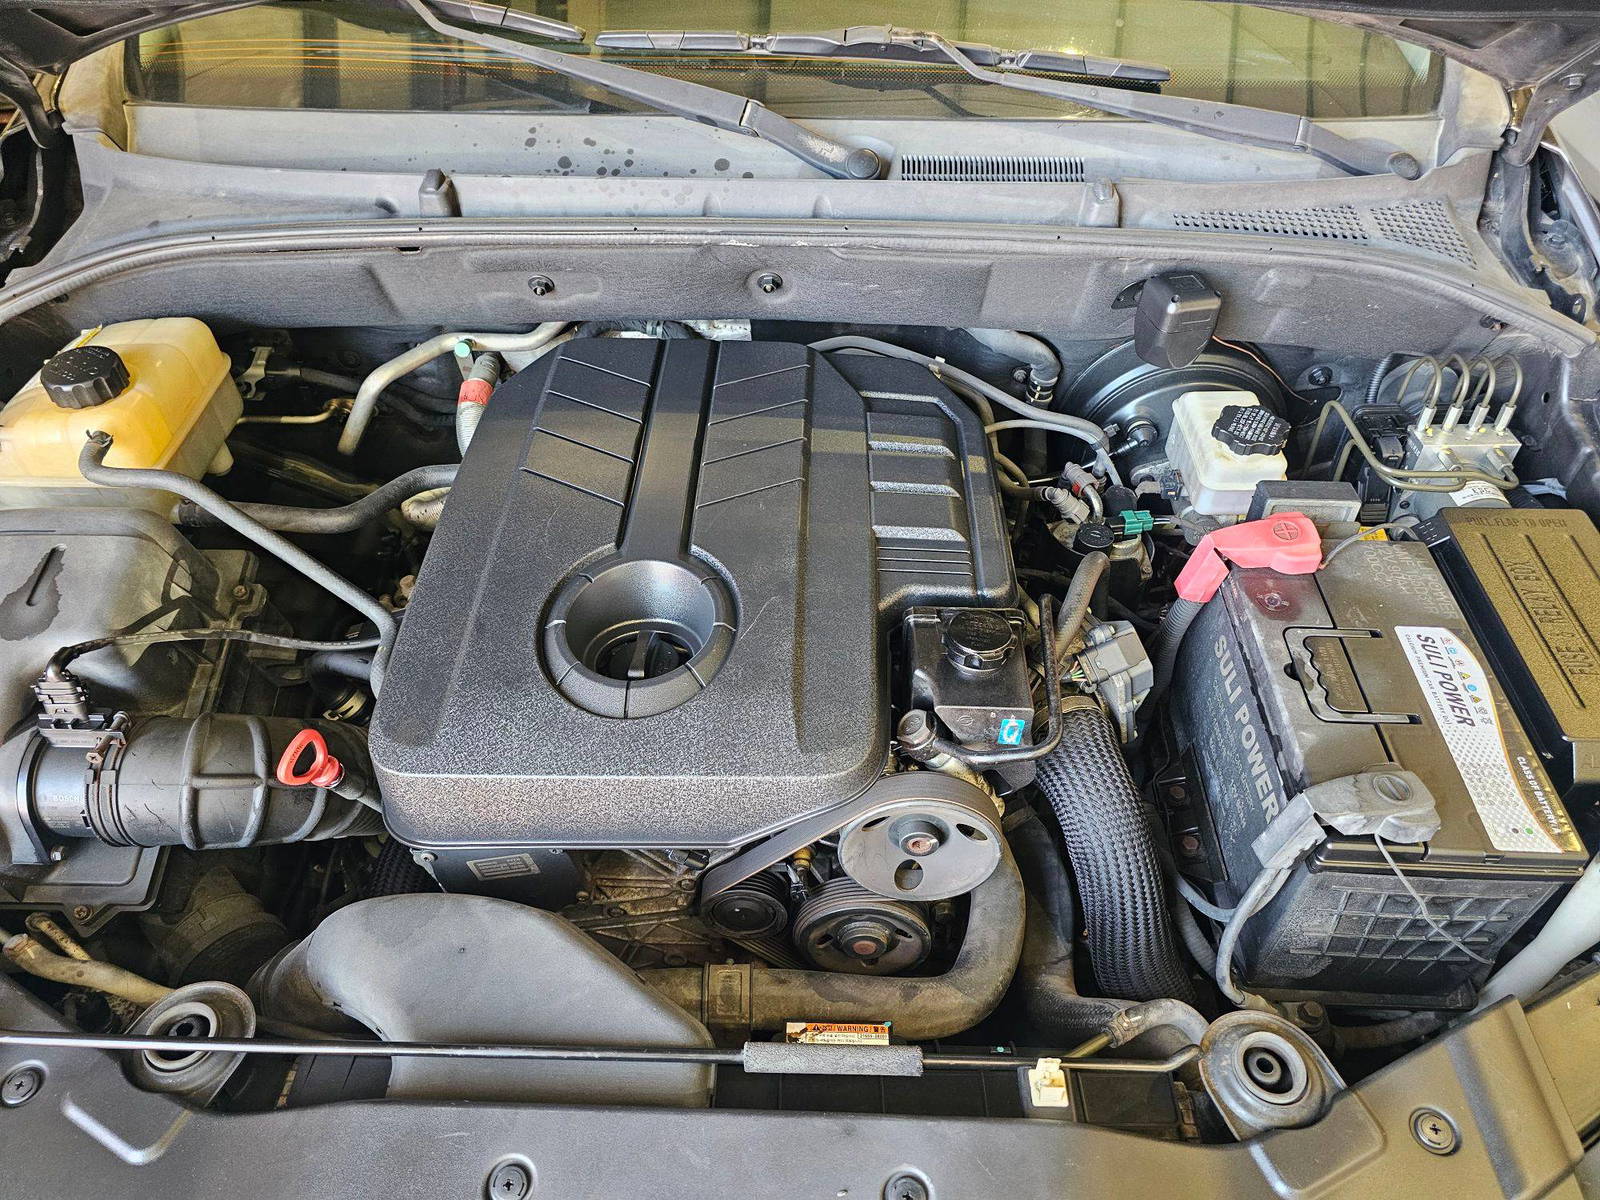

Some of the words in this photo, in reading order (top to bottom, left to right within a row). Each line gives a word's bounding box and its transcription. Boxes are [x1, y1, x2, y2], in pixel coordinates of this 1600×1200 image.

[1496, 518, 1520, 527] FLAP
[1524, 519, 1536, 527] TO
[1539, 519, 1568, 528] OPEN
[1504, 560, 1541, 580] BOX
[1421, 573, 1460, 618] POWER
[1520, 588, 1570, 623] RELAY
[1554, 646, 1600, 675] FUSE
[1416, 633, 1448, 669] SULI
[1433, 670, 1476, 727] POWER
[1426, 677, 1435, 690] CAR
[1431, 690, 1447, 715] BATTERY
[1213, 634, 1243, 705] SULI
[1234, 702, 1280, 825] POWER
[1516, 756, 1535, 780] CLASS
[1528, 780, 1540, 790] OF
[53, 794, 80, 802] BOSCH
